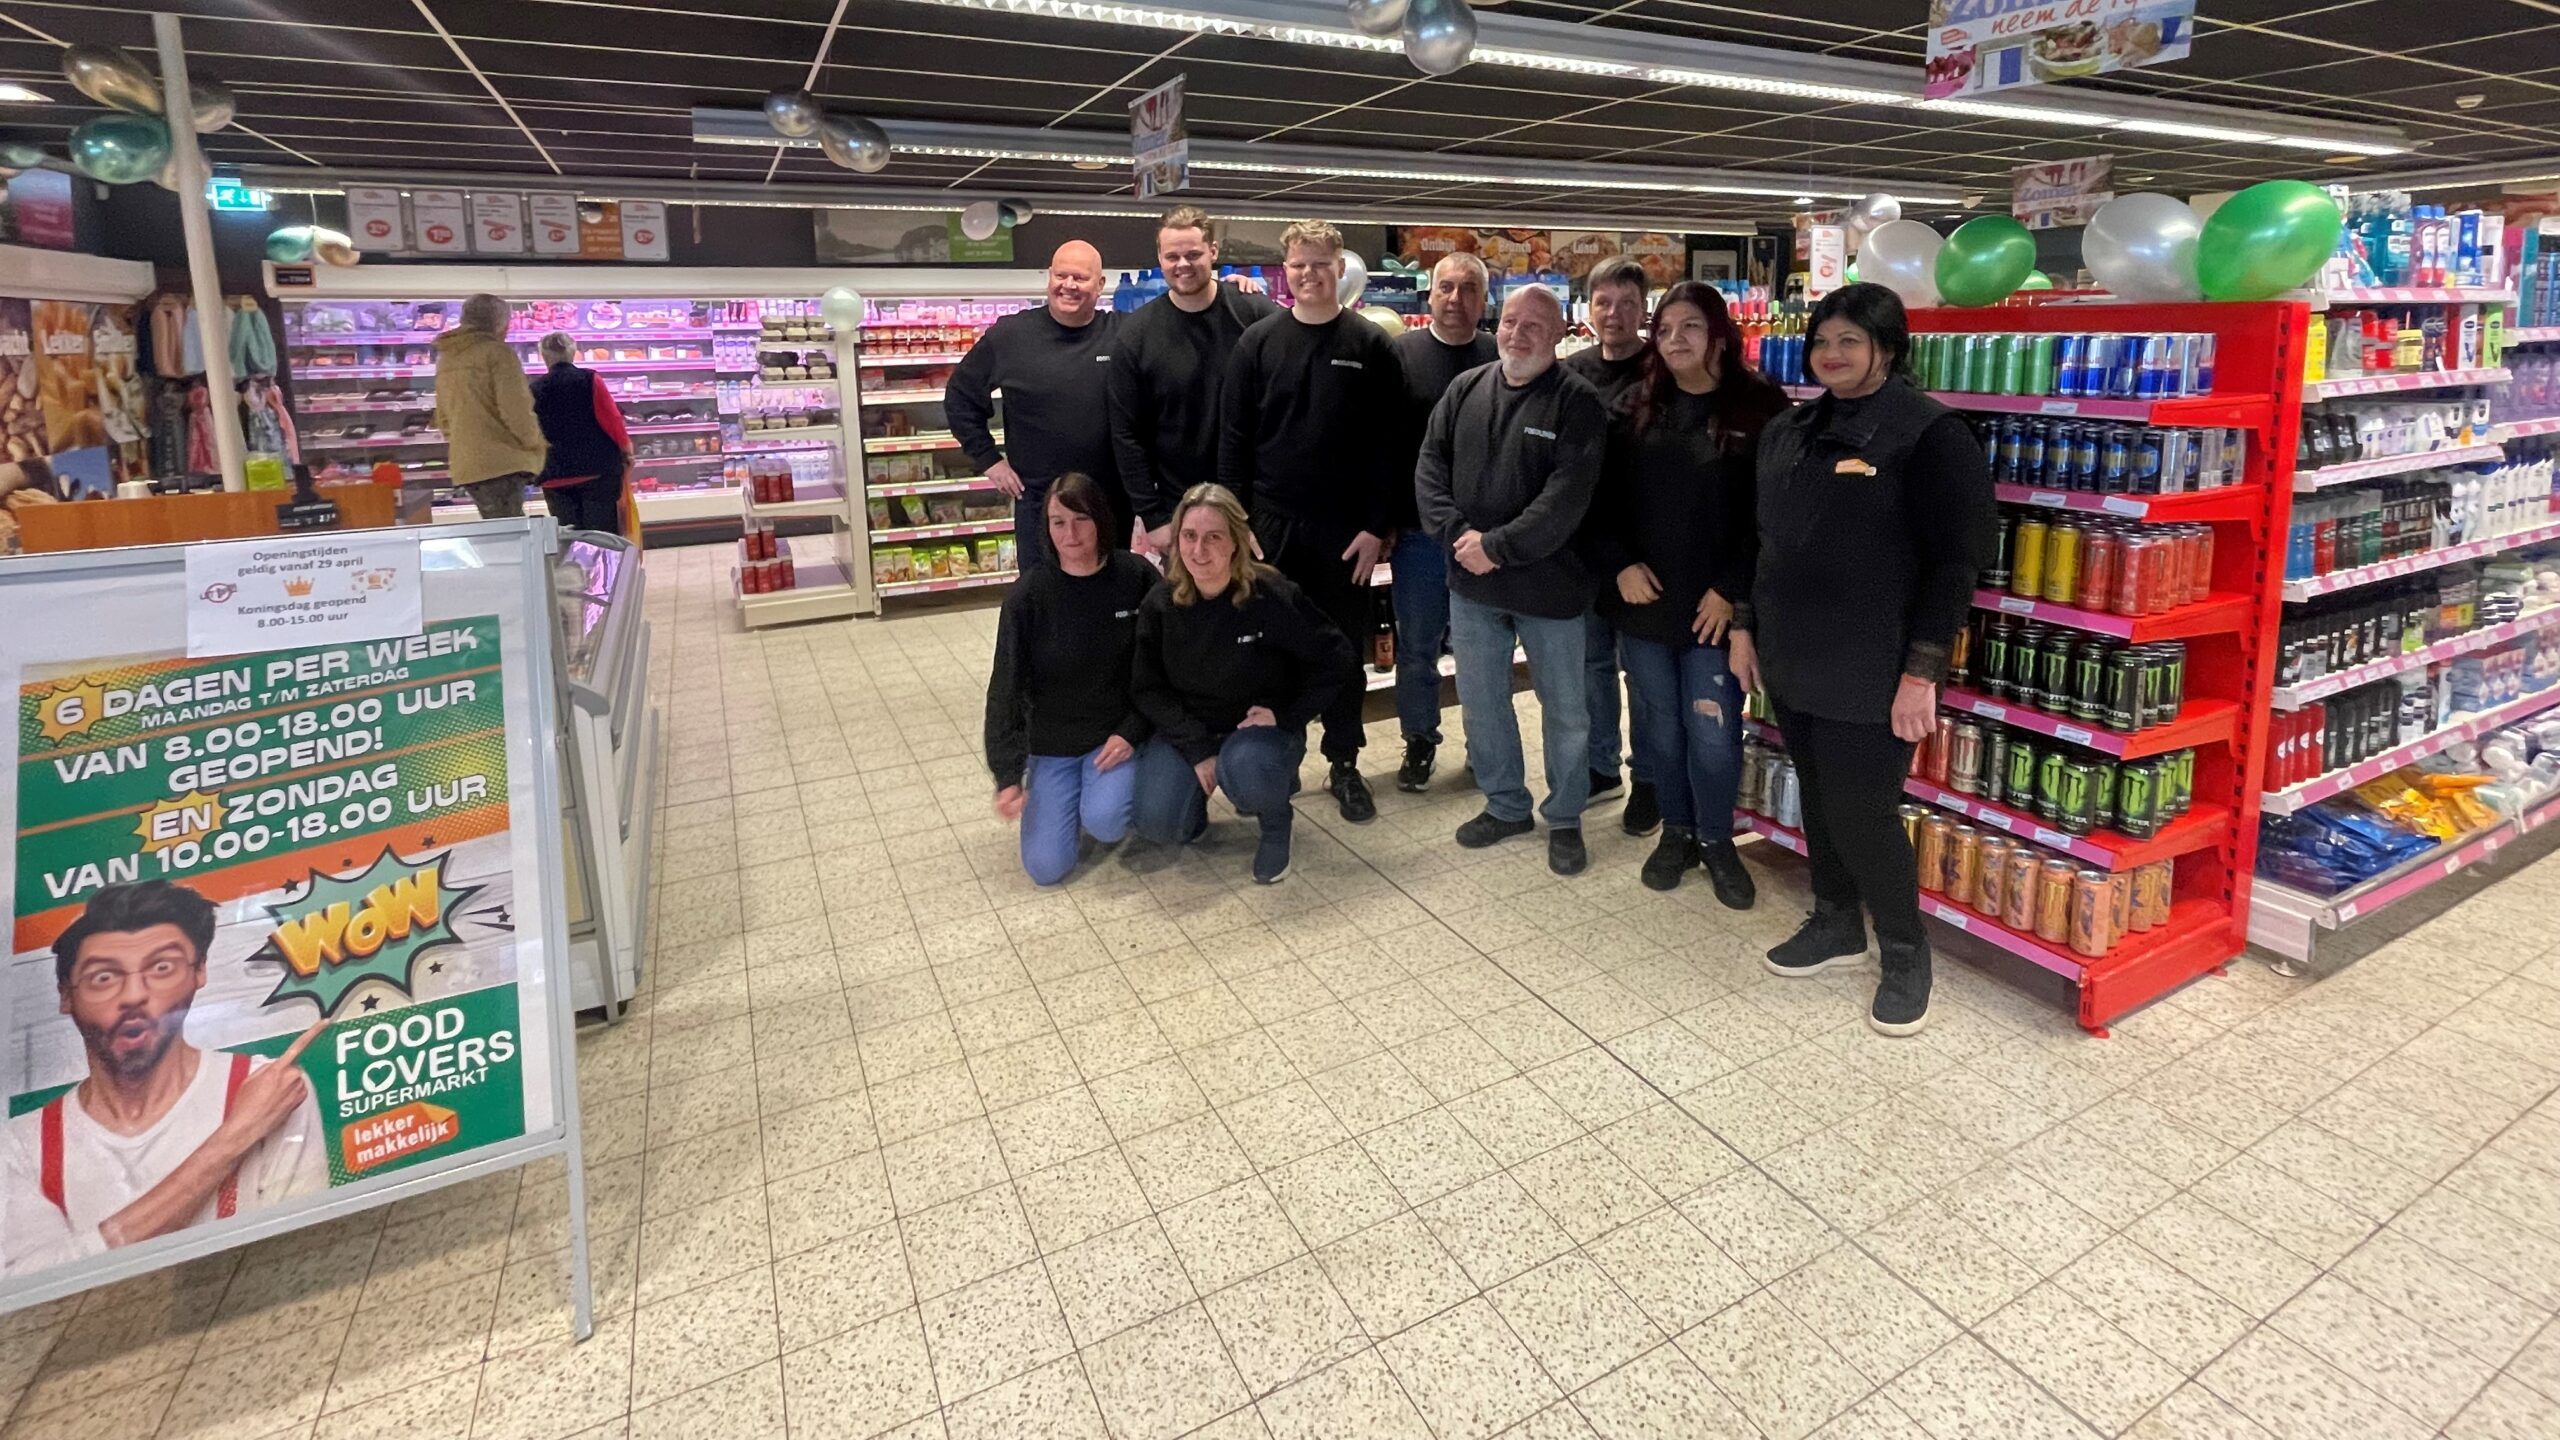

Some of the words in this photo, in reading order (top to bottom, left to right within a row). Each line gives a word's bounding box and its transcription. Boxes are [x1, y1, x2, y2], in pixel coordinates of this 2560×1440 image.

[1991, 7, 2057, 34] neem
[237, 563, 277, 577] geldig
[279, 559, 314, 571] vanaf
[318, 558, 333, 569] 29
[335, 556, 364, 570] april
[253, 546, 348, 562] Openingstijden
[238, 600, 311, 616] Koningsdag
[313, 595, 367, 611] geopend
[257, 613, 325, 628] 8.00-15.00
[327, 612, 349, 622] uur
[55, 696, 86, 725] 6
[102, 667, 251, 718] DAGEN
[265, 649, 350, 690] PER
[367, 627, 479, 667] WEEK
[140, 697, 251, 729] MAANDAG
[258, 685, 300, 704] T/M
[306, 666, 409, 696] ZATERDAG
[53, 743, 147, 784] VAN
[163, 701, 383, 762] 8.00-18.00
[397, 679, 477, 716] UUR
[167, 728, 384, 793] GEOPEND!
[151, 803, 212, 841] EN
[227, 764, 399, 825] ZONDAG
[44, 855, 139, 899] VAN
[155, 795, 392, 872] 10.00-18.00
[406, 775, 487, 814] UUR
[335, 1006, 465, 1064] FOOD
[336, 1030, 515, 1101] LOVERS
[339, 1066, 488, 1118] SUPERMARKT
[353, 1112, 415, 1146] lekker
[357, 1119, 451, 1164] makkelijk
